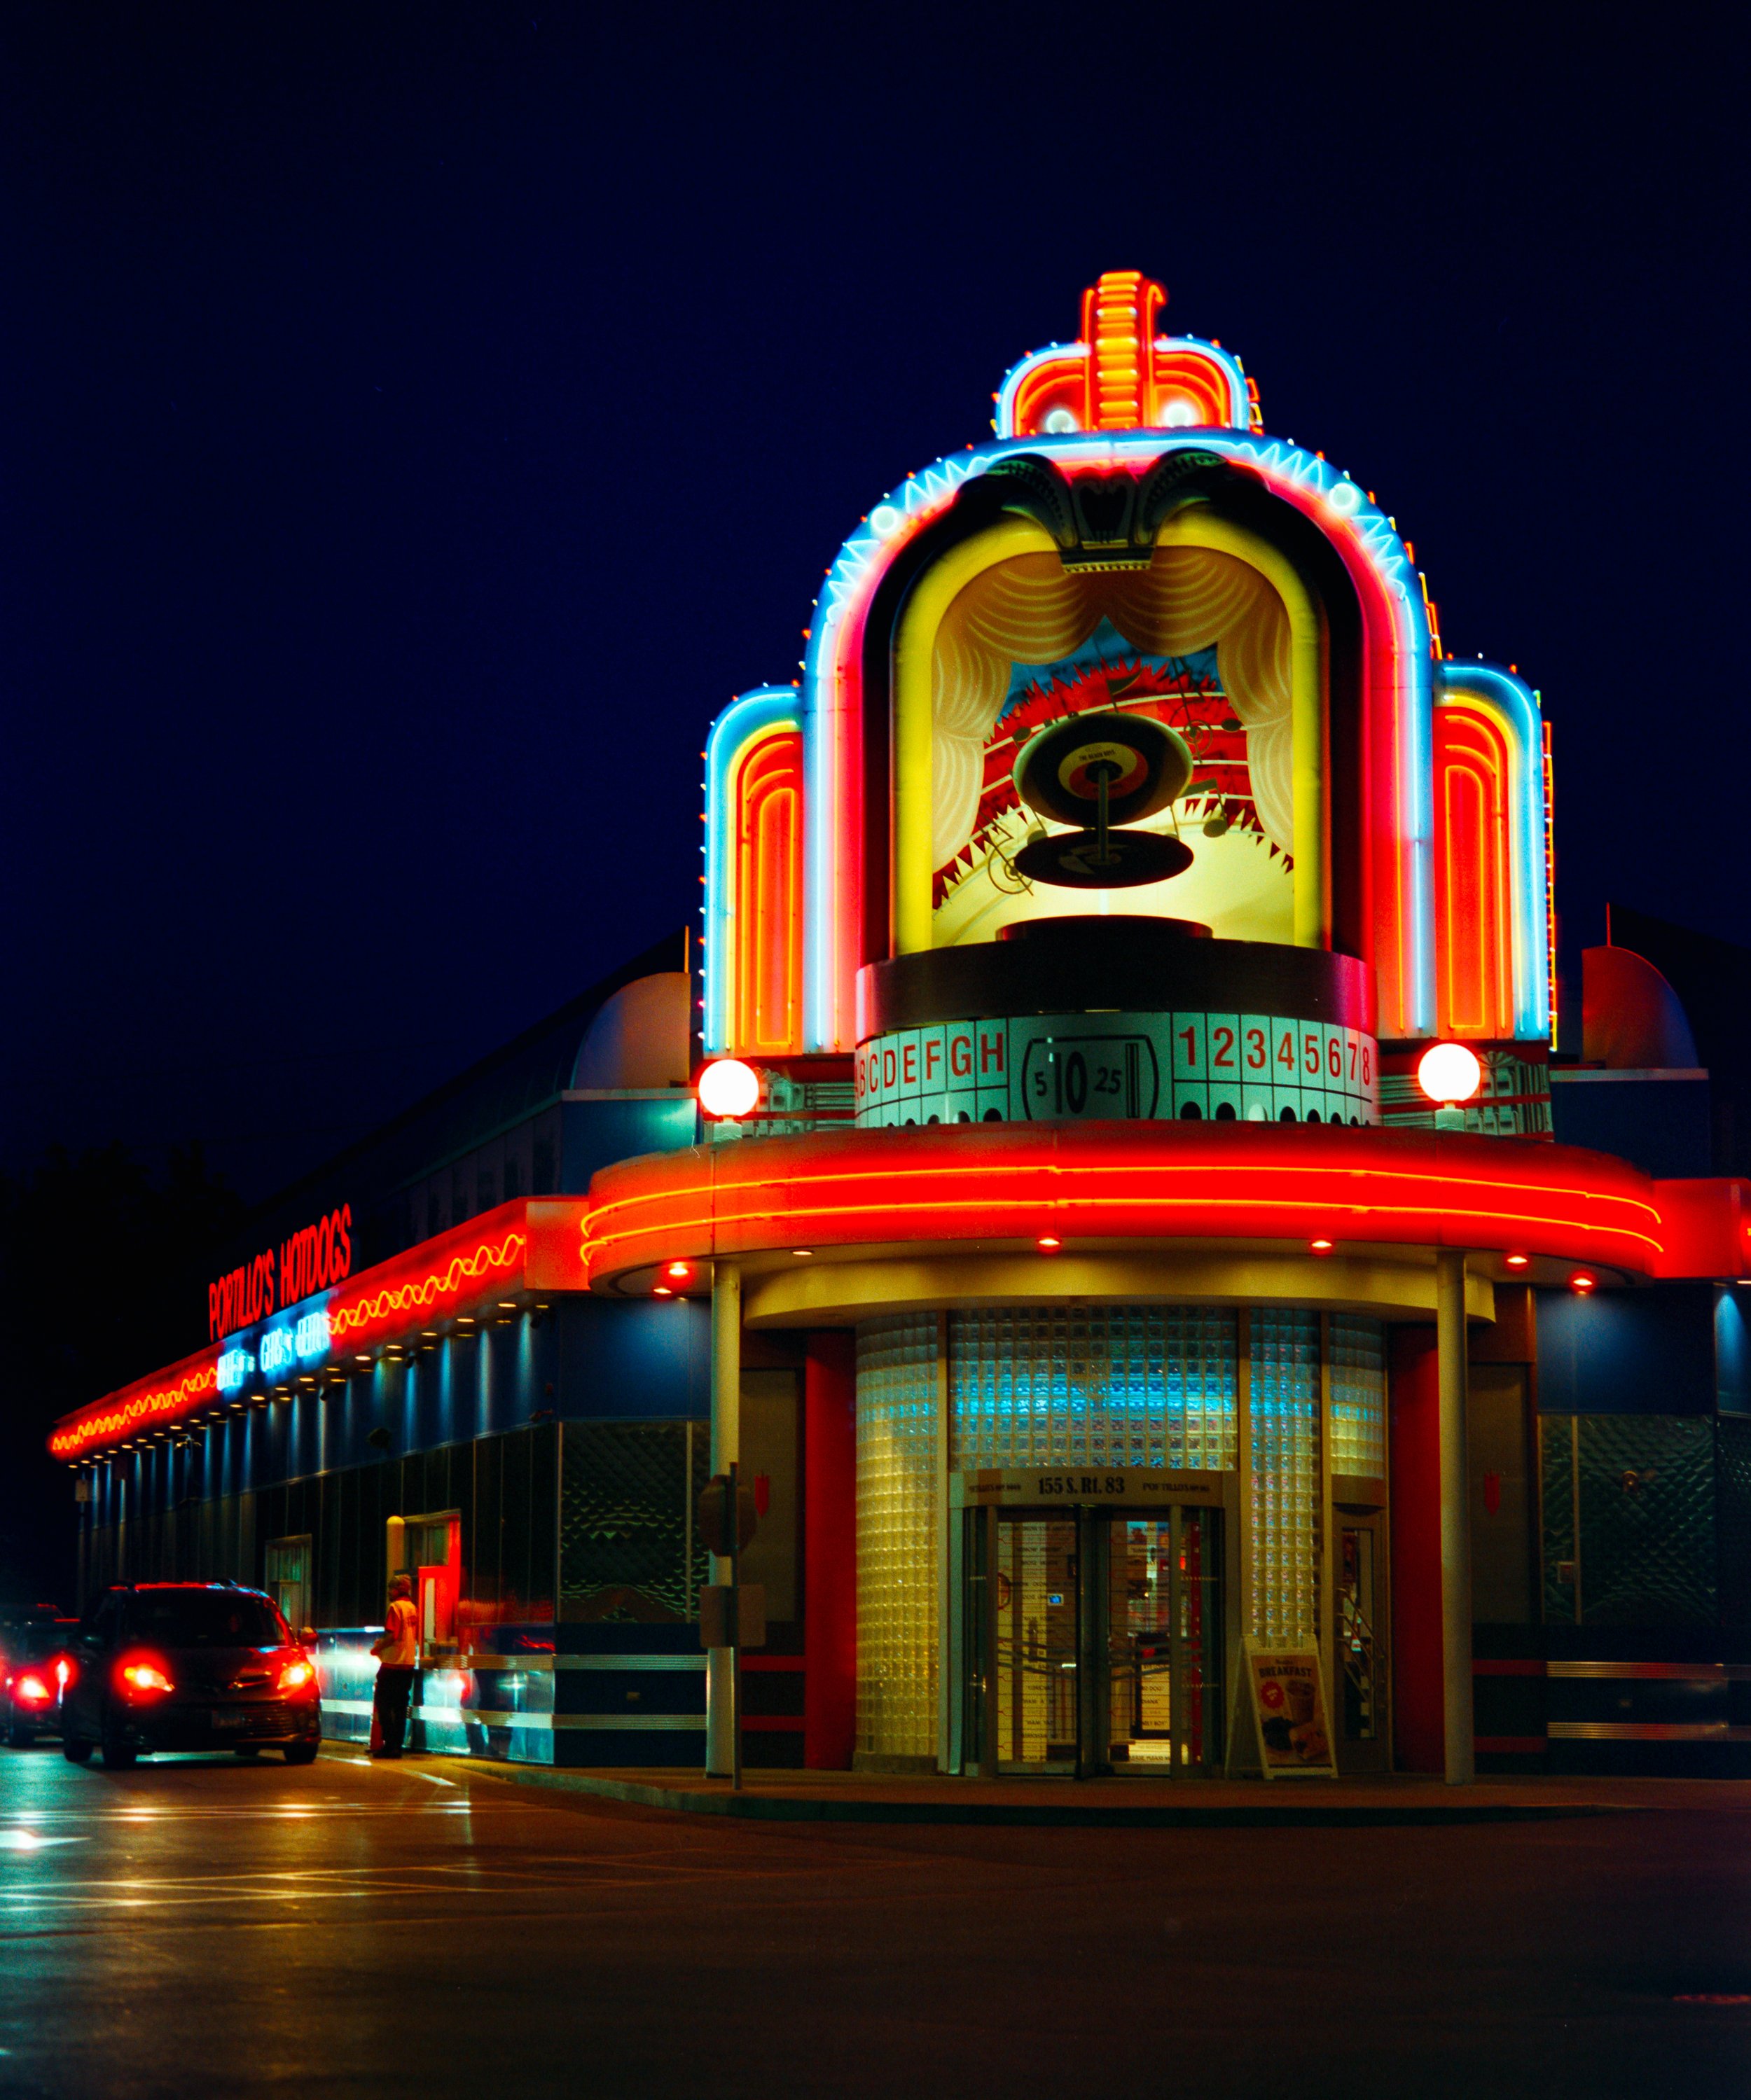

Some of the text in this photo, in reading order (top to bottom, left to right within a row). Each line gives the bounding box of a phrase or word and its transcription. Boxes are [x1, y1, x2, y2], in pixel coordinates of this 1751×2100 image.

[1033, 1070, 1047, 1097] 5
[1094, 1066, 1123, 1096] 25
[209, 1248, 275, 1342] PORTILLO'S
[1038, 1476, 1125, 1494] 155 S. Rt. 83
[1259, 1667, 1313, 1678] BREAKFAST
